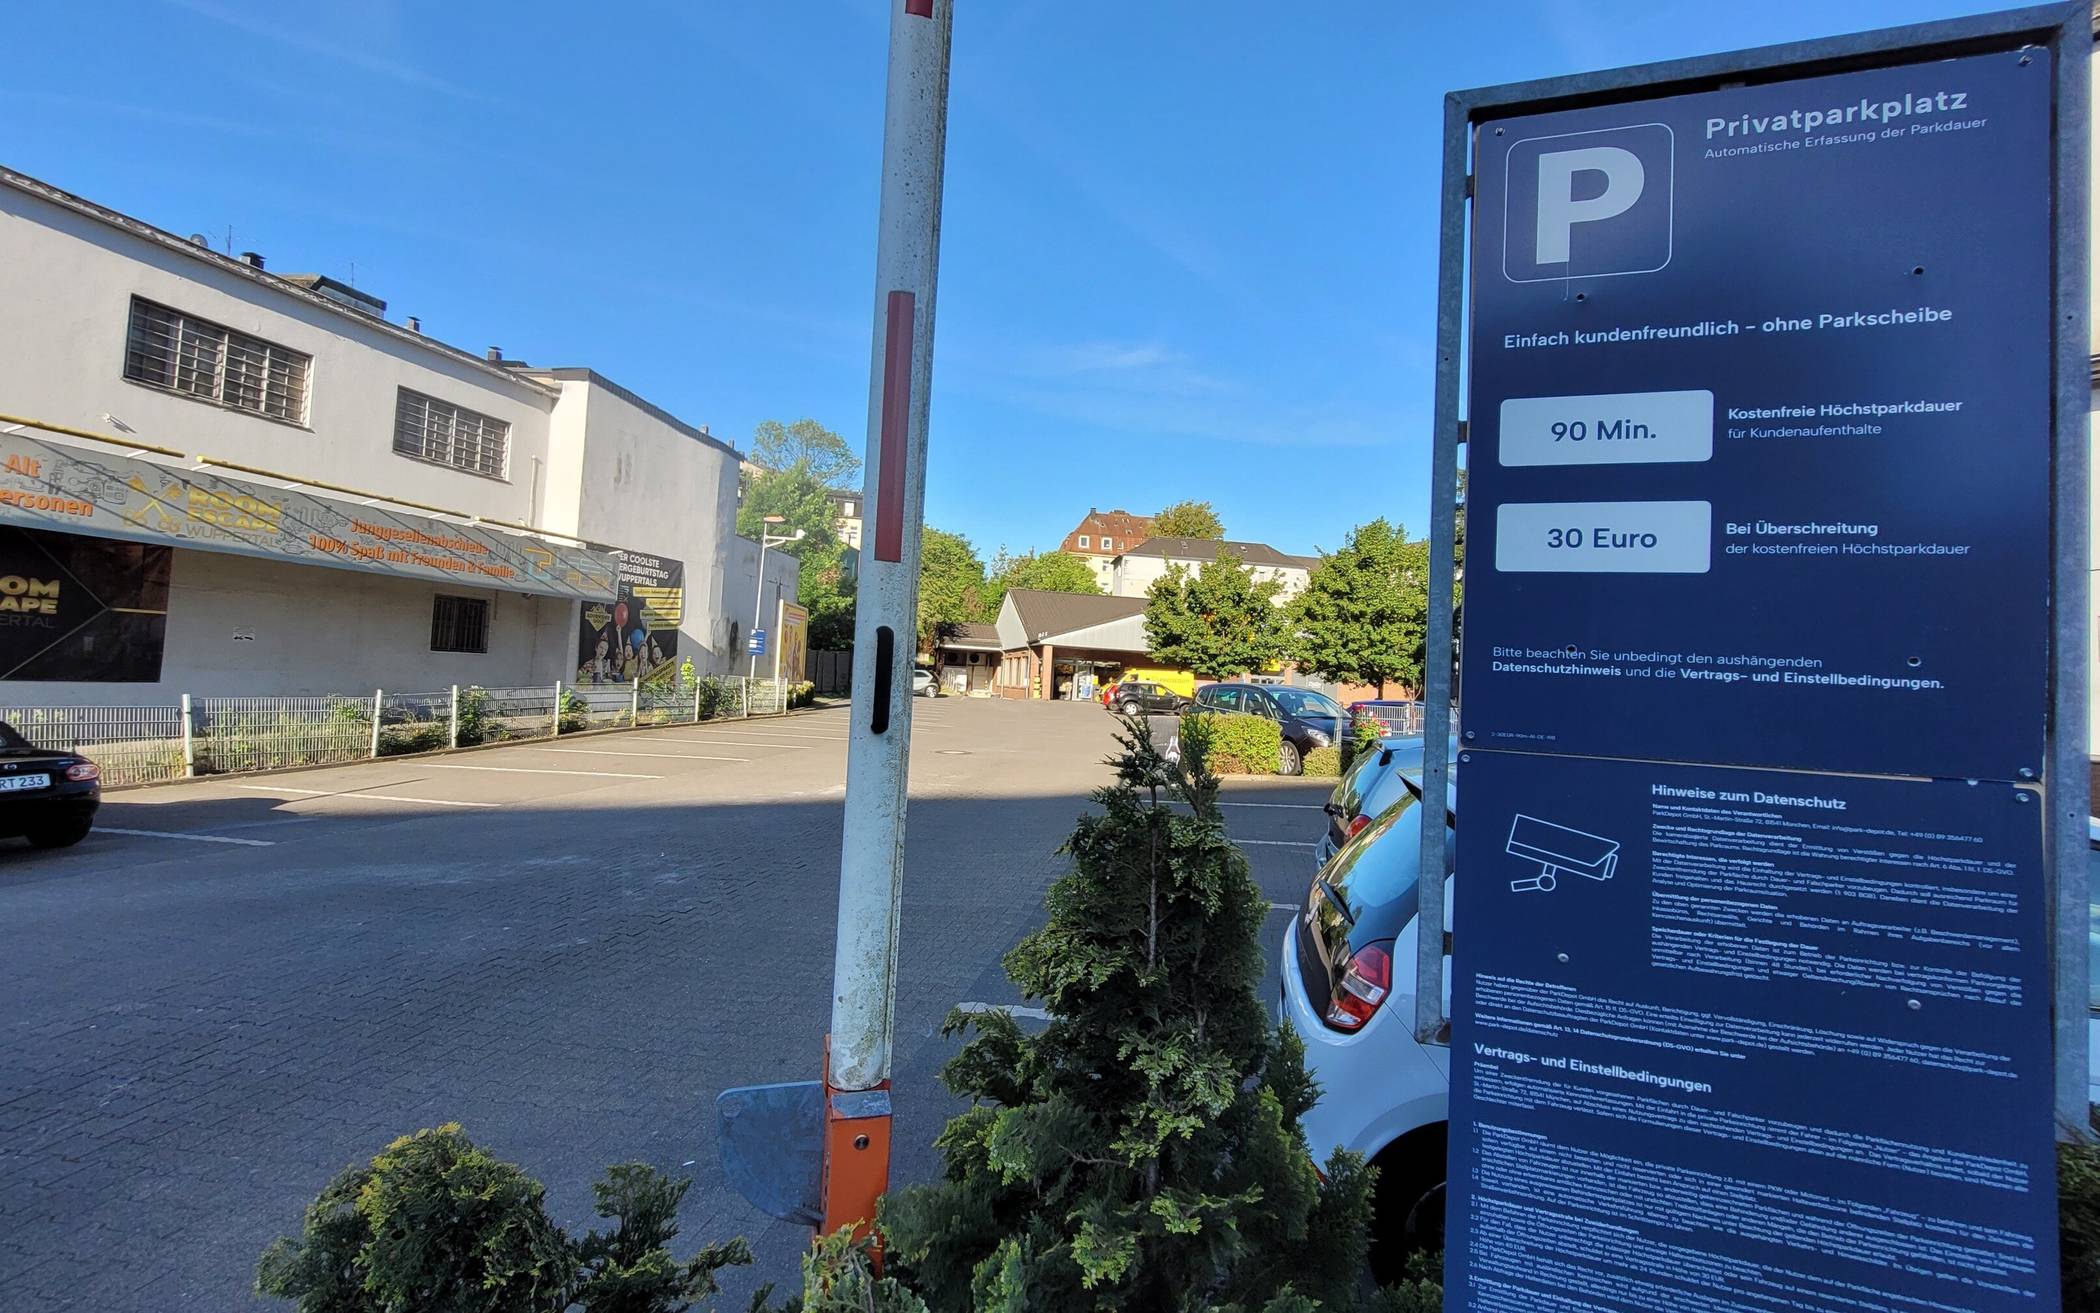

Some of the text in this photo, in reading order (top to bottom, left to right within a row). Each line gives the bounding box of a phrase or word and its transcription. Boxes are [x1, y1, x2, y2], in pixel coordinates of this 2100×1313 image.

[1706, 91, 1968, 139] Privatparkplatz
[1704, 117, 1988, 159] Automatische Erfassung der Parkdauer
[1536, 146, 1646, 265] P
[1504, 330, 1570, 349] Einfach
[1575, 320, 1740, 345] kundenfreundlich
[1762, 317, 1813, 333] ohne
[1819, 306, 1953, 330] Parkscheibe
[1728, 399, 1963, 420] Kostenfreie Höchstparkdauer
[1550, 419, 1657, 443] 90 Min.
[1728, 423, 1882, 439] für Kundenaufenthalte
[5, 453, 42, 478] Alt
[187, 485, 282, 519] ROOM
[186, 506, 280, 535] ESCAPE
[1726, 520, 1878, 536] Bei Überschreitung
[186, 523, 281, 548] WUPPERTAL
[351, 519, 490, 555] Junggesellenabschiede
[1547, 527, 1658, 549] 30 Euro
[309, 533, 515, 579] 100% Spaß mit Freunden & Familie
[629, 554, 660, 569] COOLSTE
[1726, 542, 1971, 558] der kostenfreien Höchstparkdauer
[1493, 646, 1823, 669] Bitte beachten Sie unbedingt den aushängenden
[1492, 661, 1945, 690] Datenschutzhinweis und die Vertrags- und Einstellbedingungen.
[20, 775, 45, 788] 233
[1652, 784, 1847, 810] Hinweise zum Datenschutz
[1474, 1042, 1712, 1092] Vertrags- und Einstellbedingungen
